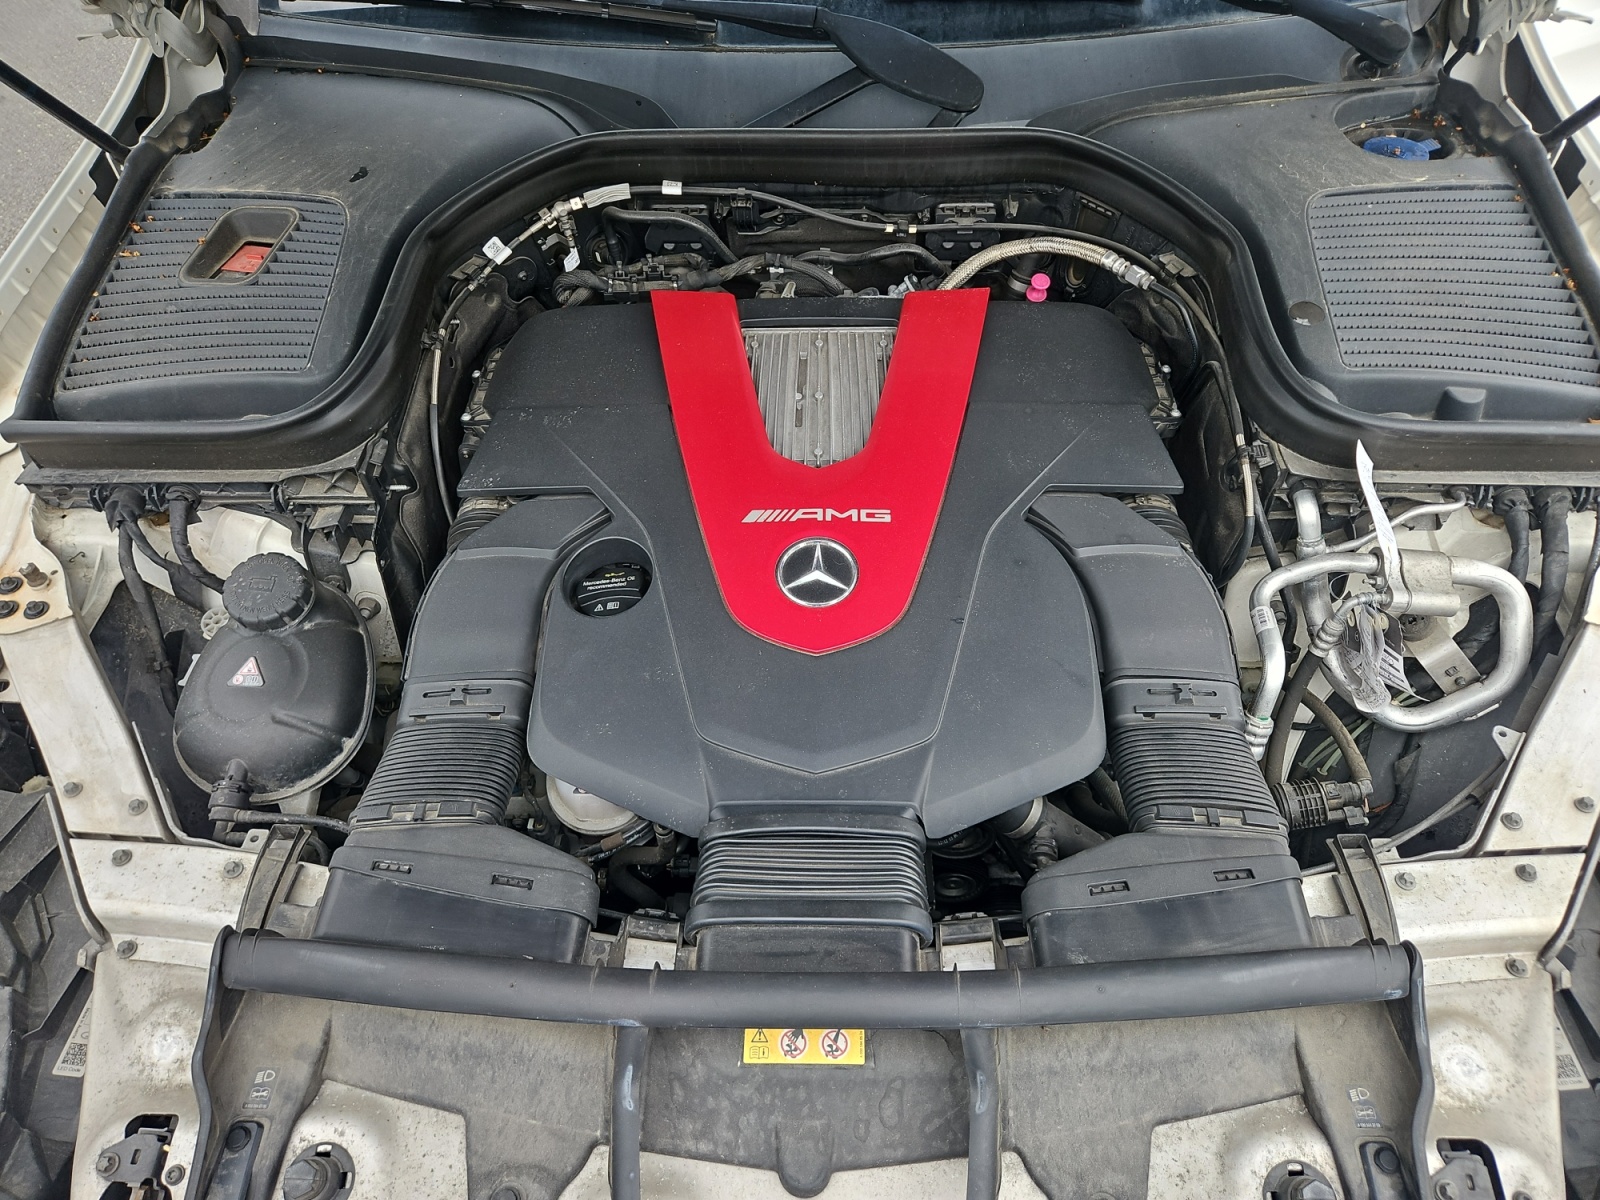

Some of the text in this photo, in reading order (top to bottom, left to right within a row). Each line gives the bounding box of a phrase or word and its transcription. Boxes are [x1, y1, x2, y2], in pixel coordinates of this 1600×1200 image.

[789, 508, 892, 523] AMG
[583, 578, 626, 587] Mercedes-Benz
[587, 582, 627, 590] recommended
